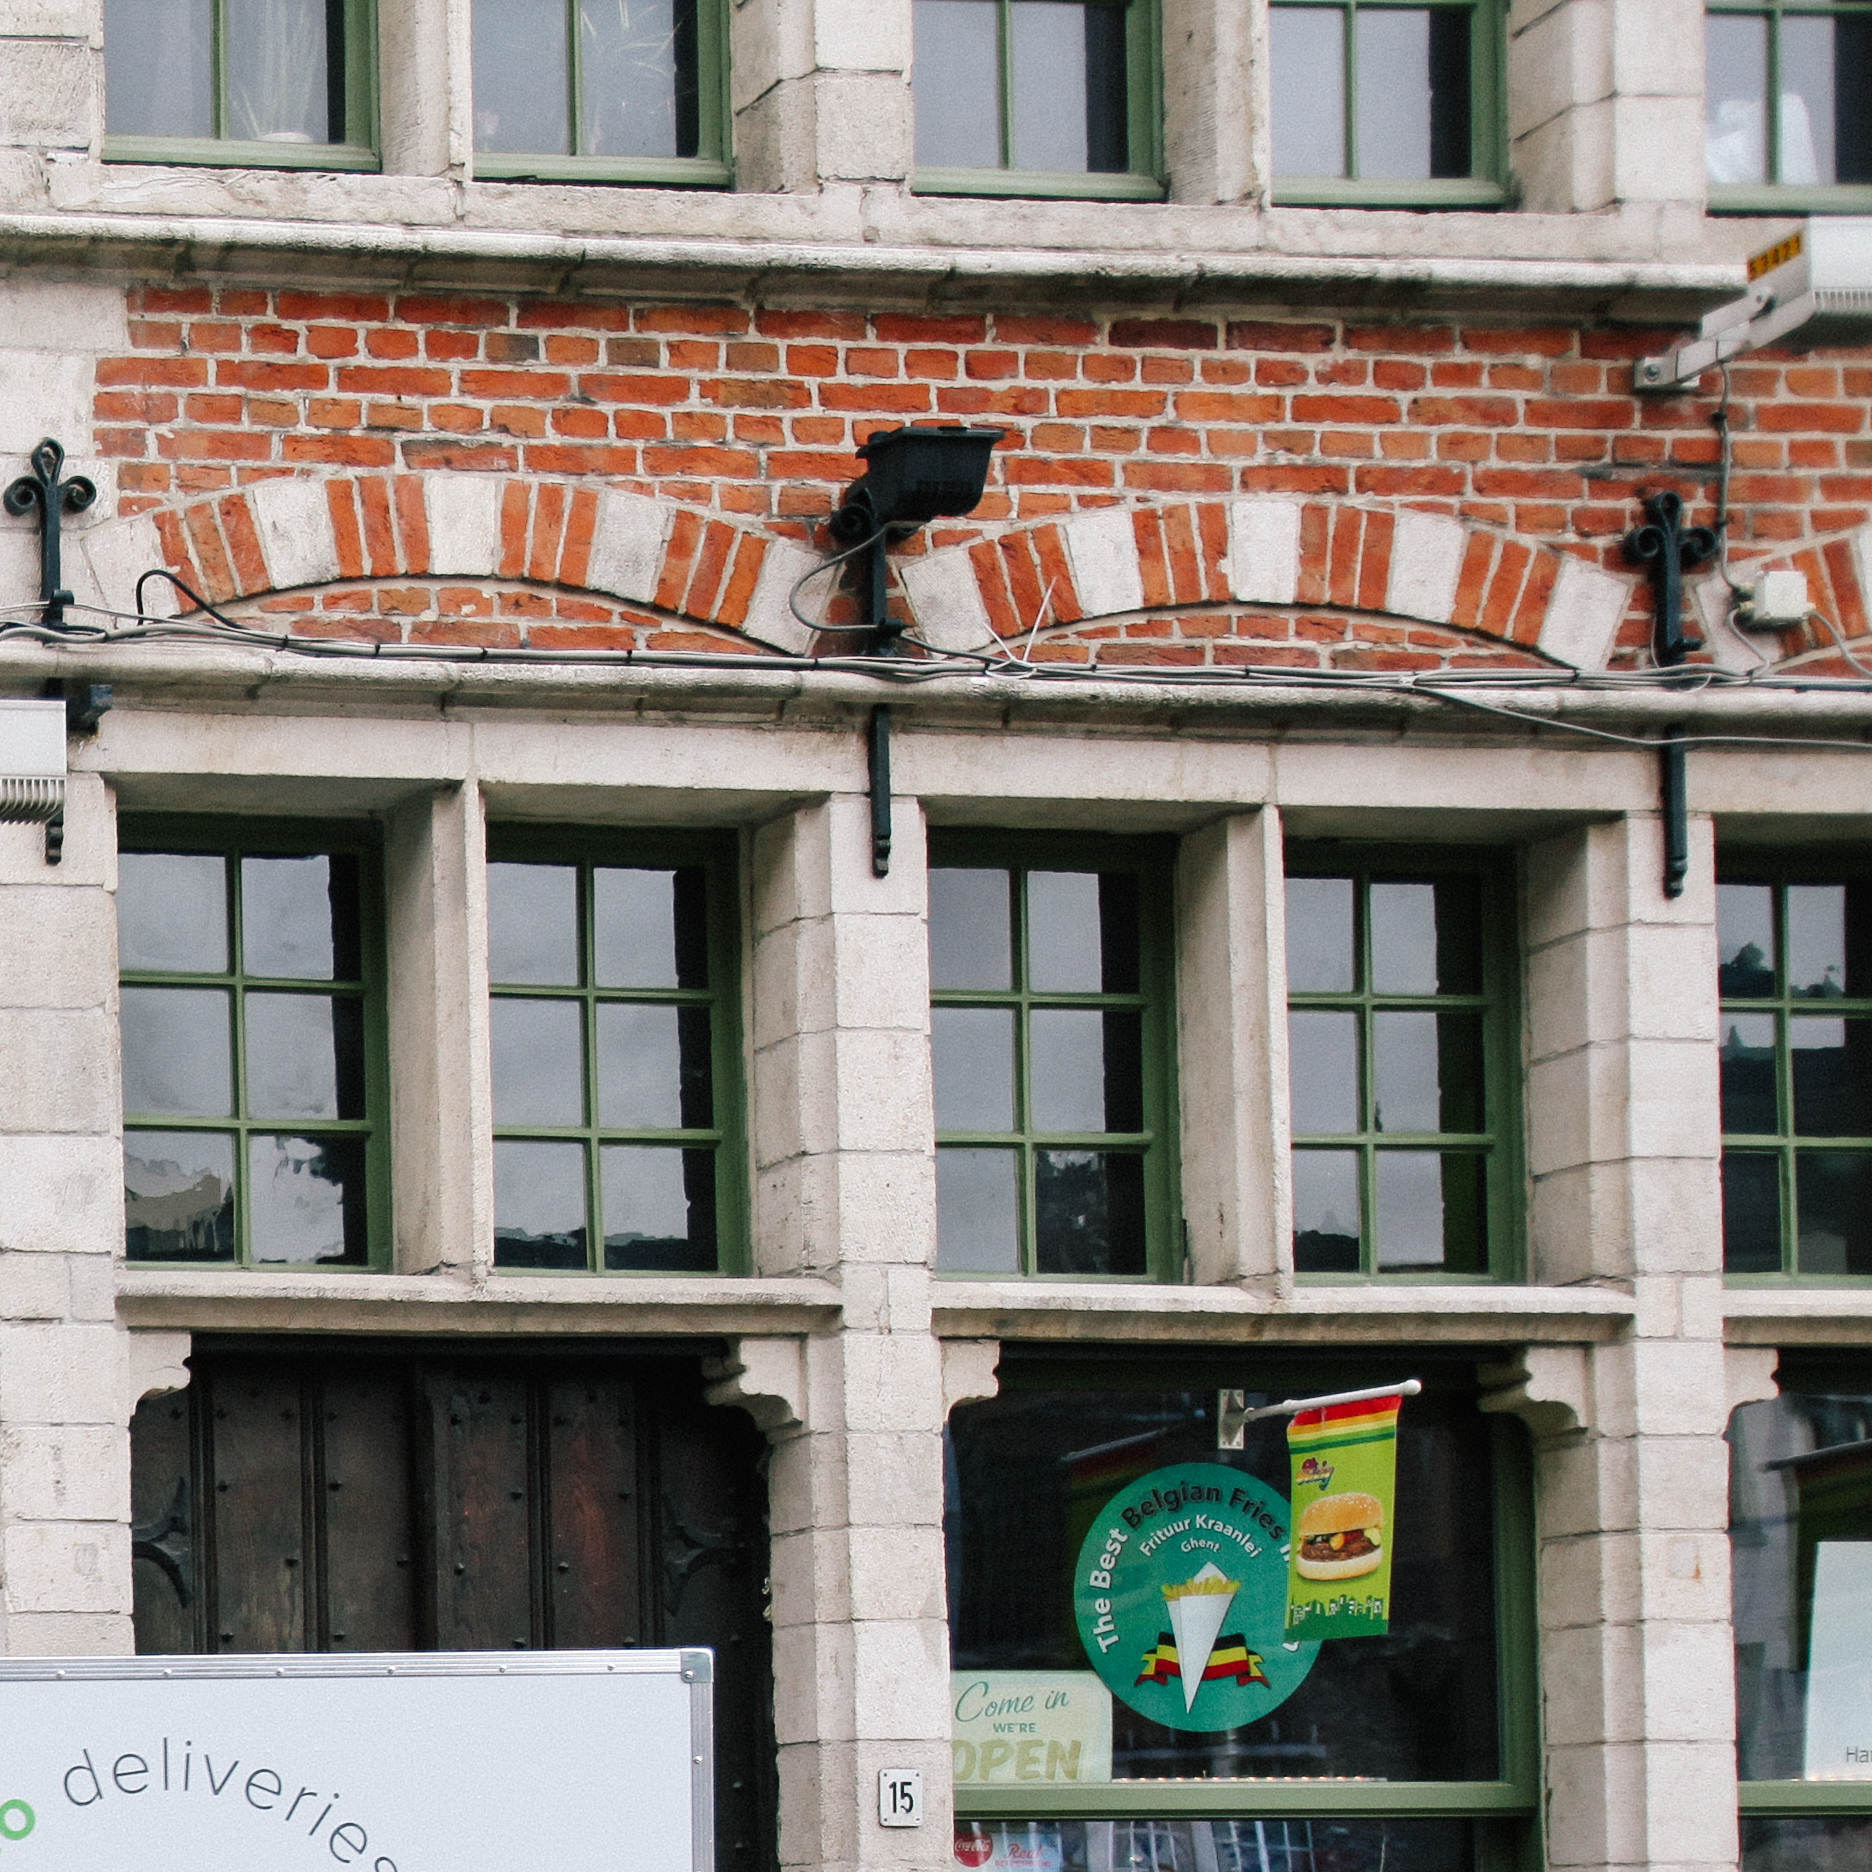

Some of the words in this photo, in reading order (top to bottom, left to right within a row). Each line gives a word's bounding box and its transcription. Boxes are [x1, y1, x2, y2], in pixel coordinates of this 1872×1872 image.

[1121, 1479, 1222, 1530] Belgian
[1228, 1487, 1287, 1541] Fries
[1089, 1527, 1130, 1589] Best
[1139, 1517, 1191, 1557] Frituur
[1196, 1514, 1262, 1558] Kraanlei
[1180, 1537, 1222, 1554] Ghent
[1092, 1599, 1120, 1653] The
[955, 1681, 1035, 1722] Come
[1045, 1689, 1070, 1709] in
[952, 1739, 1082, 1781] OPEN
[888, 1781, 914, 1814] 15
